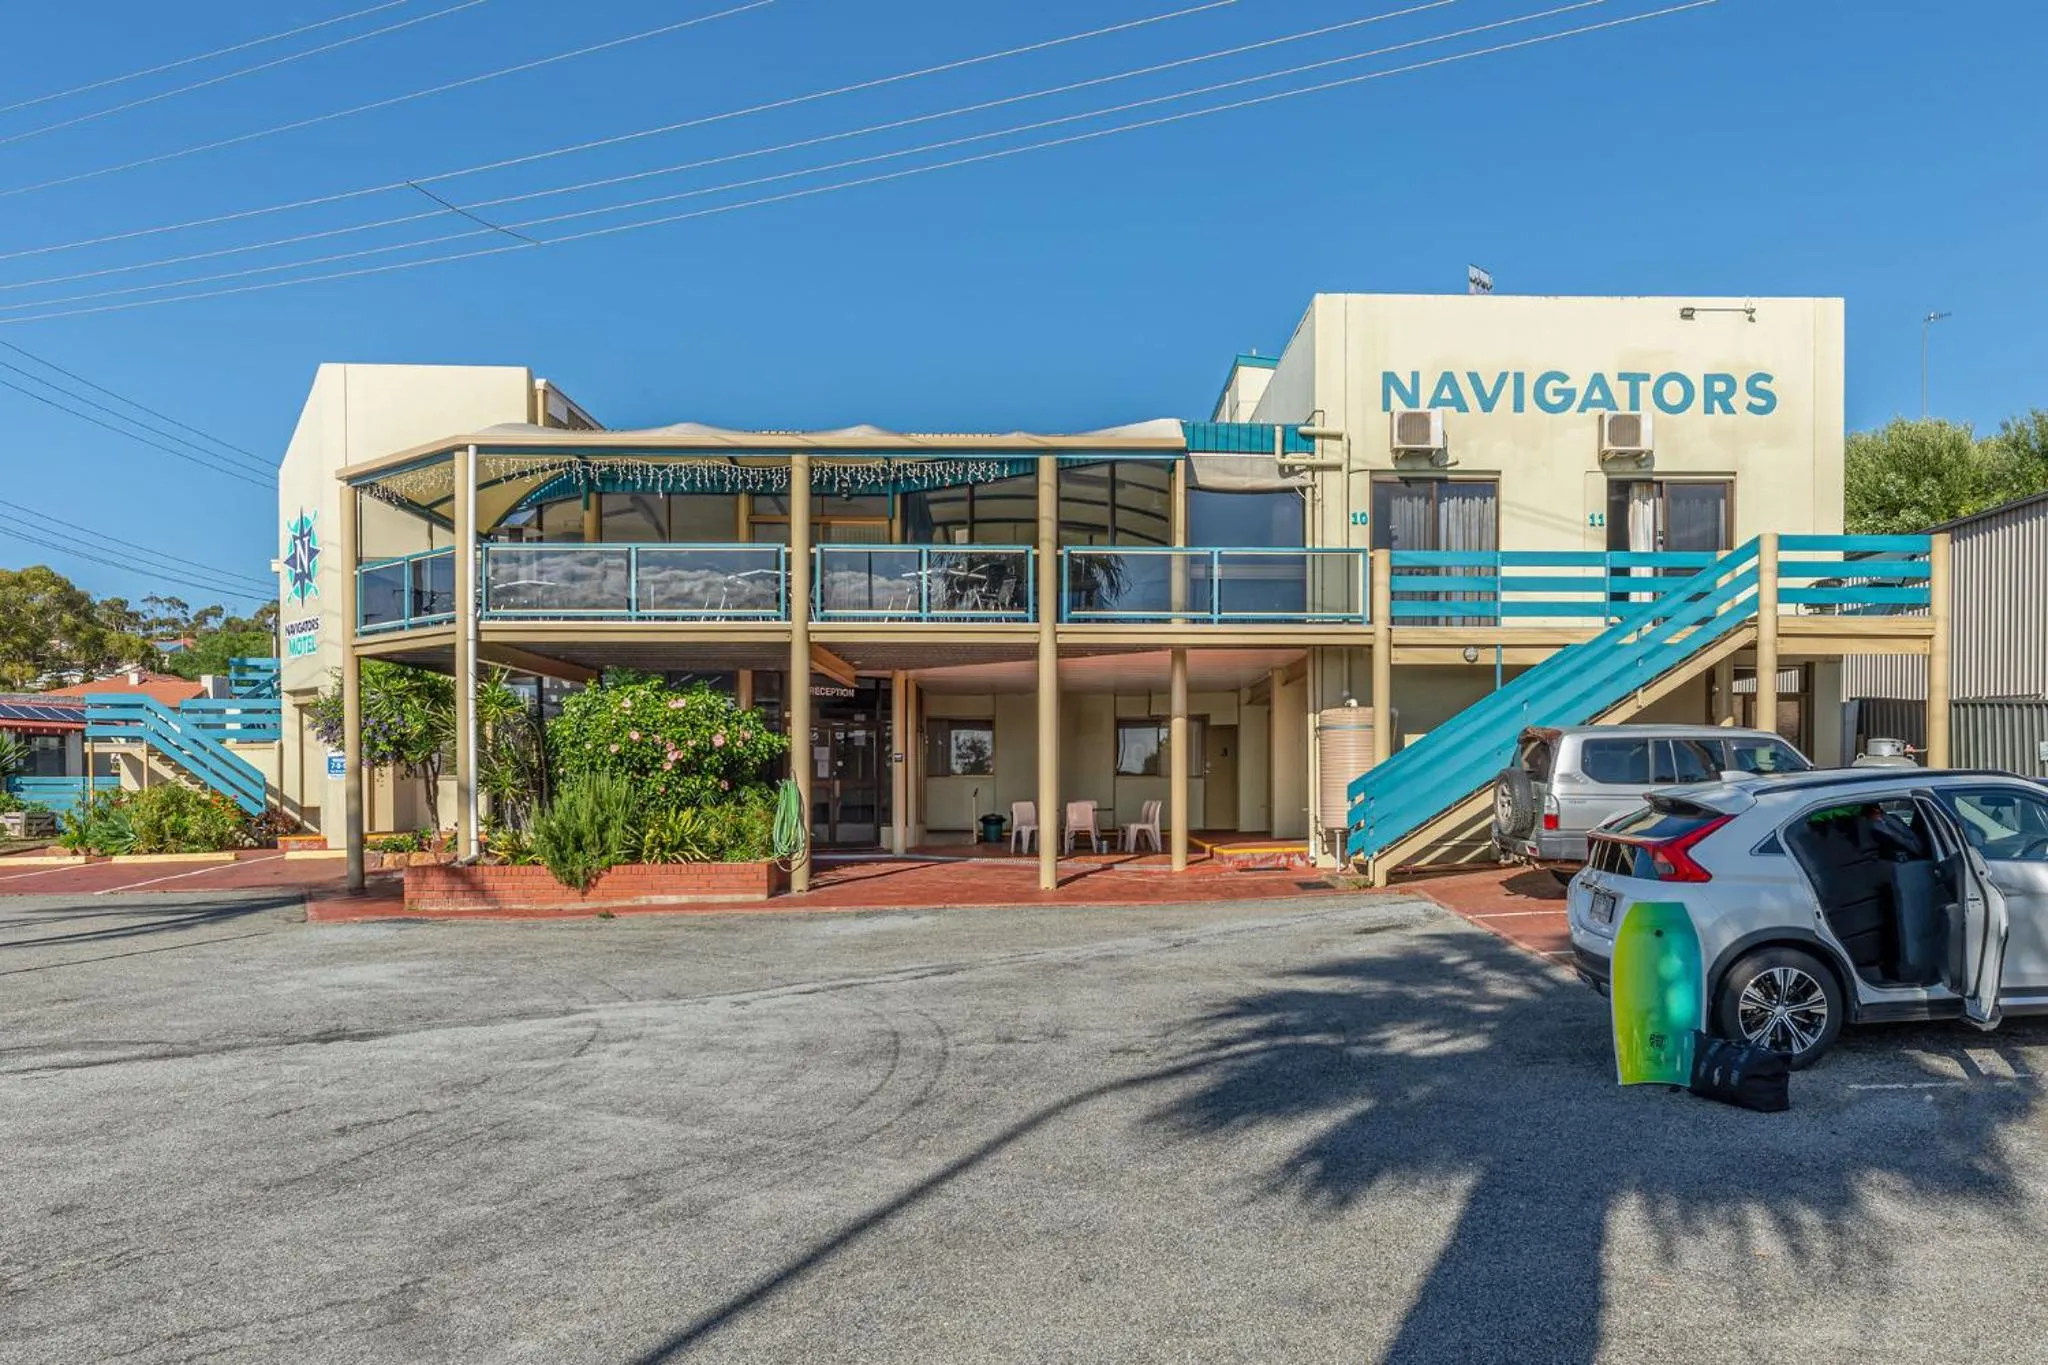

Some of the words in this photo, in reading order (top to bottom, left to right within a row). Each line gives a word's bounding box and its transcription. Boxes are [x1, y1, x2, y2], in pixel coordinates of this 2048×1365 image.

[1382, 371, 1777, 415] NAVIGATORS
[1351, 512, 1369, 525] 10
[1588, 512, 1605, 527] 11
[294, 536, 310, 574] N
[285, 617, 319, 636] NAVIGATORS
[288, 635, 316, 655] MOTEL
[809, 686, 855, 698] RECEPTION
